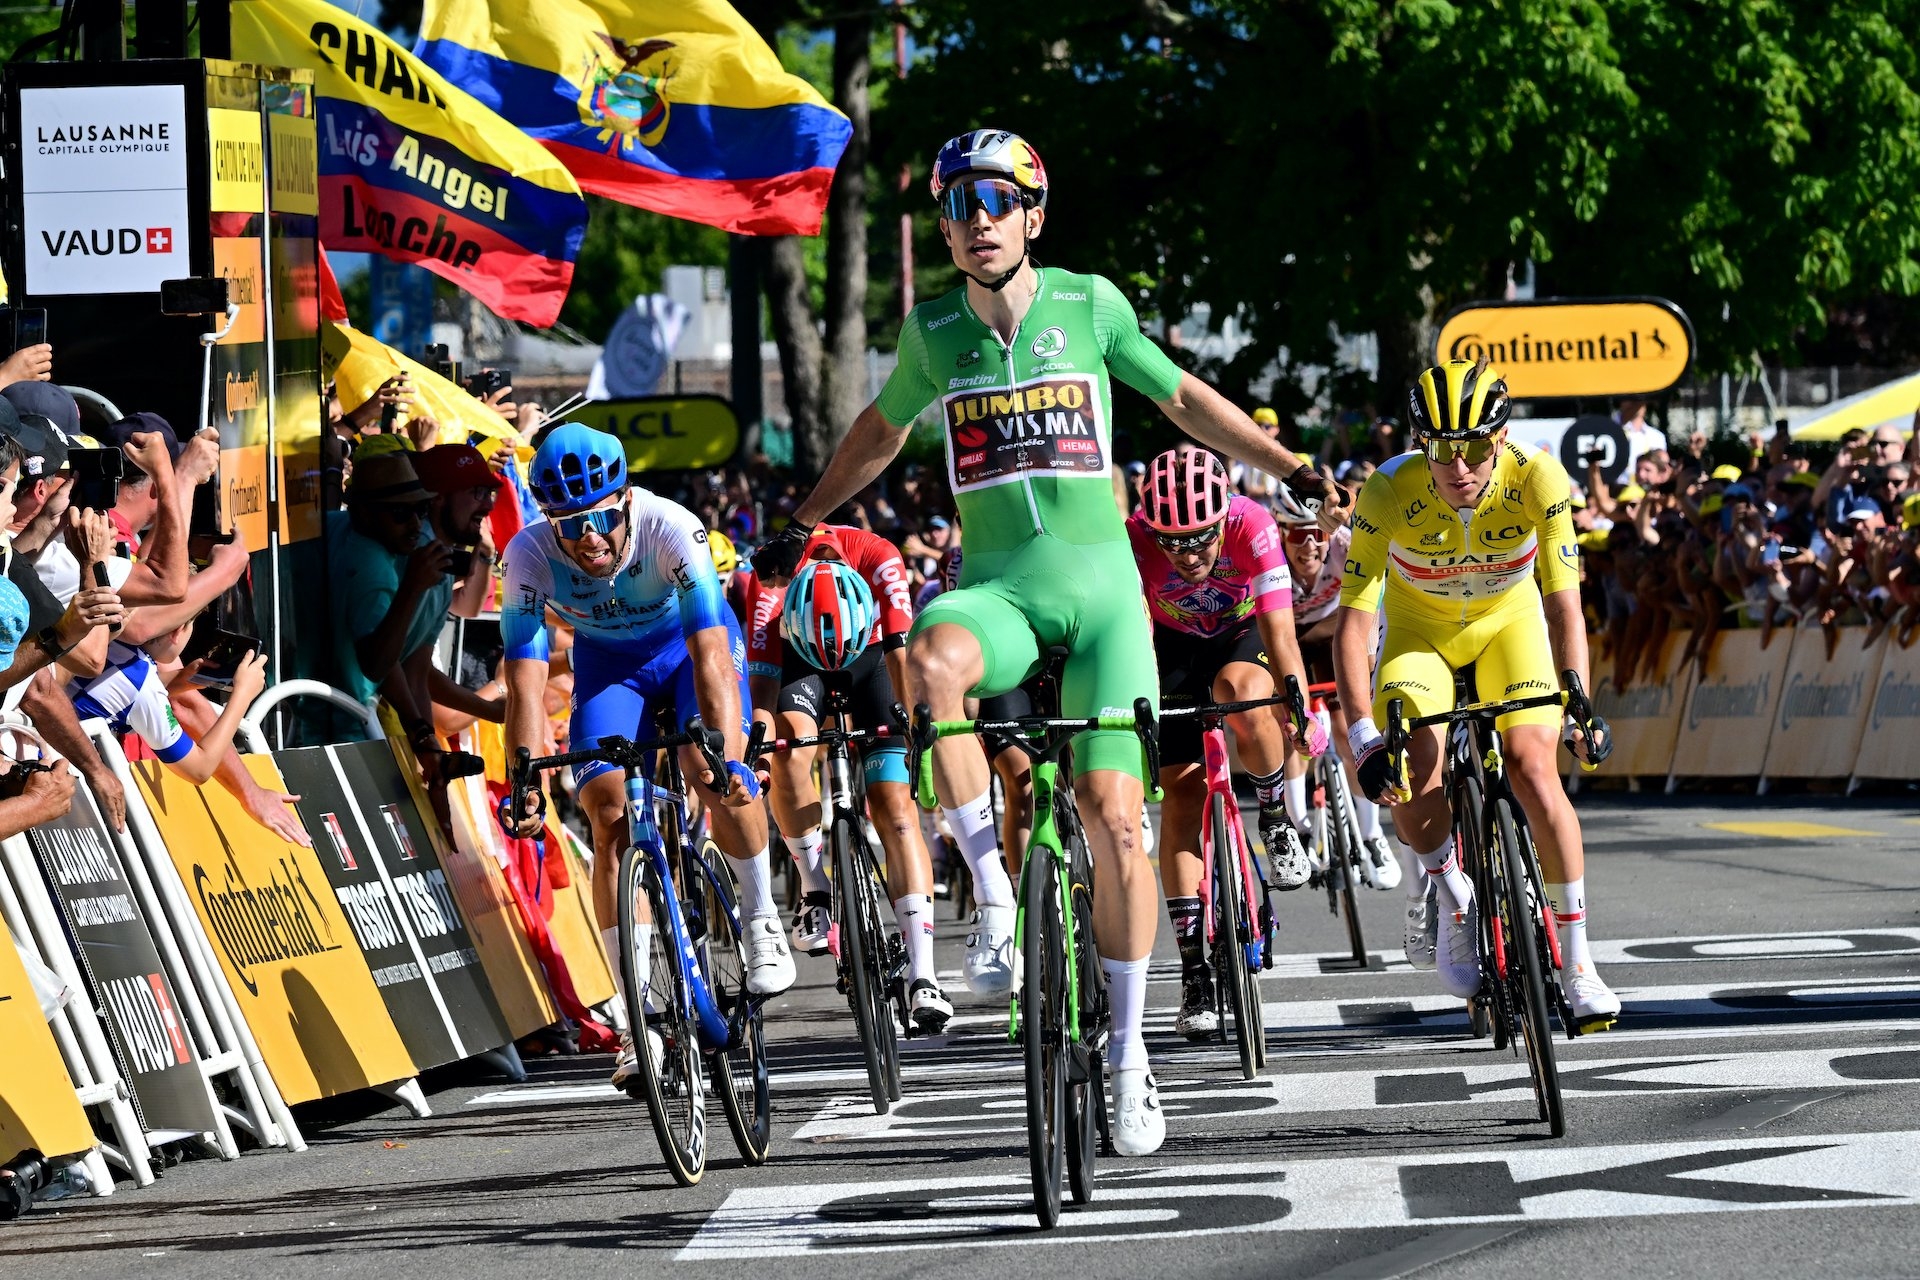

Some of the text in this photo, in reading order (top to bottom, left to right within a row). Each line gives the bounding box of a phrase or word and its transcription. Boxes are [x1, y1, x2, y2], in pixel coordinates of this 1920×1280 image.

[309, 21, 446, 110] CHA
[38, 124, 169, 143] LAUSANNE
[38, 143, 170, 155] CAPITALE OLYMPIQUE
[215, 140, 238, 182] CANTON
[239, 141, 247, 183] DE
[325, 113, 509, 221] Luis Angel
[41, 228, 142, 257] VAUD
[1052, 290, 1087, 302] ŠKODA
[926, 311, 961, 331] ŠKODA
[1449, 331, 1640, 363] Continental
[1031, 361, 1076, 375] ŠKODA
[948, 373, 998, 390] Santini
[953, 384, 1085, 427] JUMBO
[607, 411, 687, 441] LCL
[994, 411, 1089, 440] VISMA
[996, 438, 1046, 452] cervélo
[1062, 441, 1094, 451] HEMA
[1577, 434, 1617, 469] 50
[959, 452, 984, 467] GORILLAS
[1050, 459, 1075, 468] graze
[229, 477, 261, 526] Continental
[1504, 486, 1524, 506] LCL
[1405, 498, 1428, 521] LCL
[1437, 512, 1456, 522] LCL
[1479, 506, 1496, 518] LCL
[1545, 498, 1571, 520] San
[1353, 514, 1379, 535] tini
[1485, 525, 1531, 541] LCL
[1343, 559, 1367, 578] CL
[1430, 563, 1509, 575] Emirates
[1431, 552, 1508, 567] UAE
[872, 556, 913, 620] lotto
[592, 597, 629, 614] BIKE
[752, 592, 780, 650] SOUDAL
[748, 662, 780, 677] stny
[1381, 680, 1430, 693] Santini
[1504, 679, 1551, 696] Santini
[983, 721, 1020, 729] cervélo
[864, 757, 886, 774] stny
[40, 827, 119, 885] LAUSANNE
[393, 869, 462, 939] TISSOT
[335, 880, 404, 951] TISSOT
[193, 857, 327, 997] Continental
[102, 975, 175, 1075] VAUD
